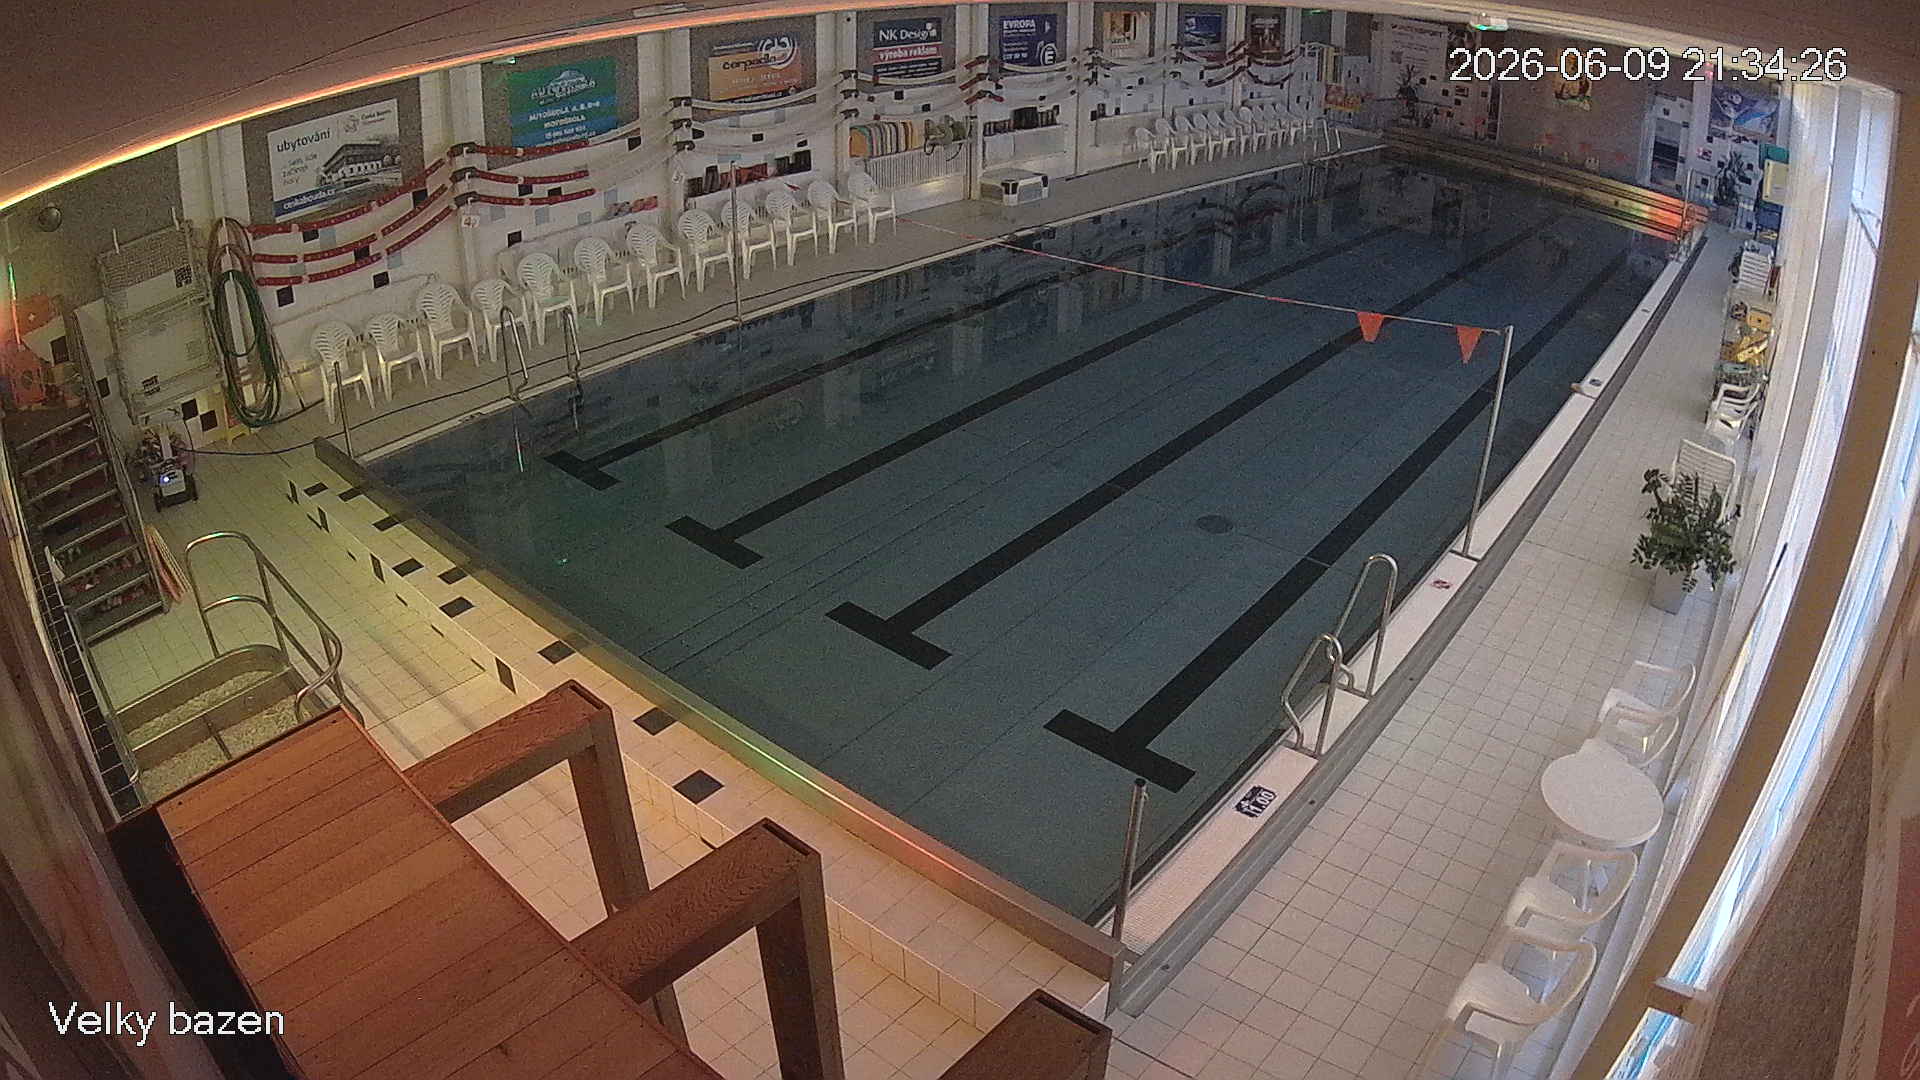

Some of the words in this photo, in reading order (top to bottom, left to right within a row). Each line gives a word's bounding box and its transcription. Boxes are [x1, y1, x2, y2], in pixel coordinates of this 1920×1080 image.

[1003, 19, 1036, 29] EVROPA
[879, 29, 898, 40] NK
[276, 128, 331, 153] ubytování
